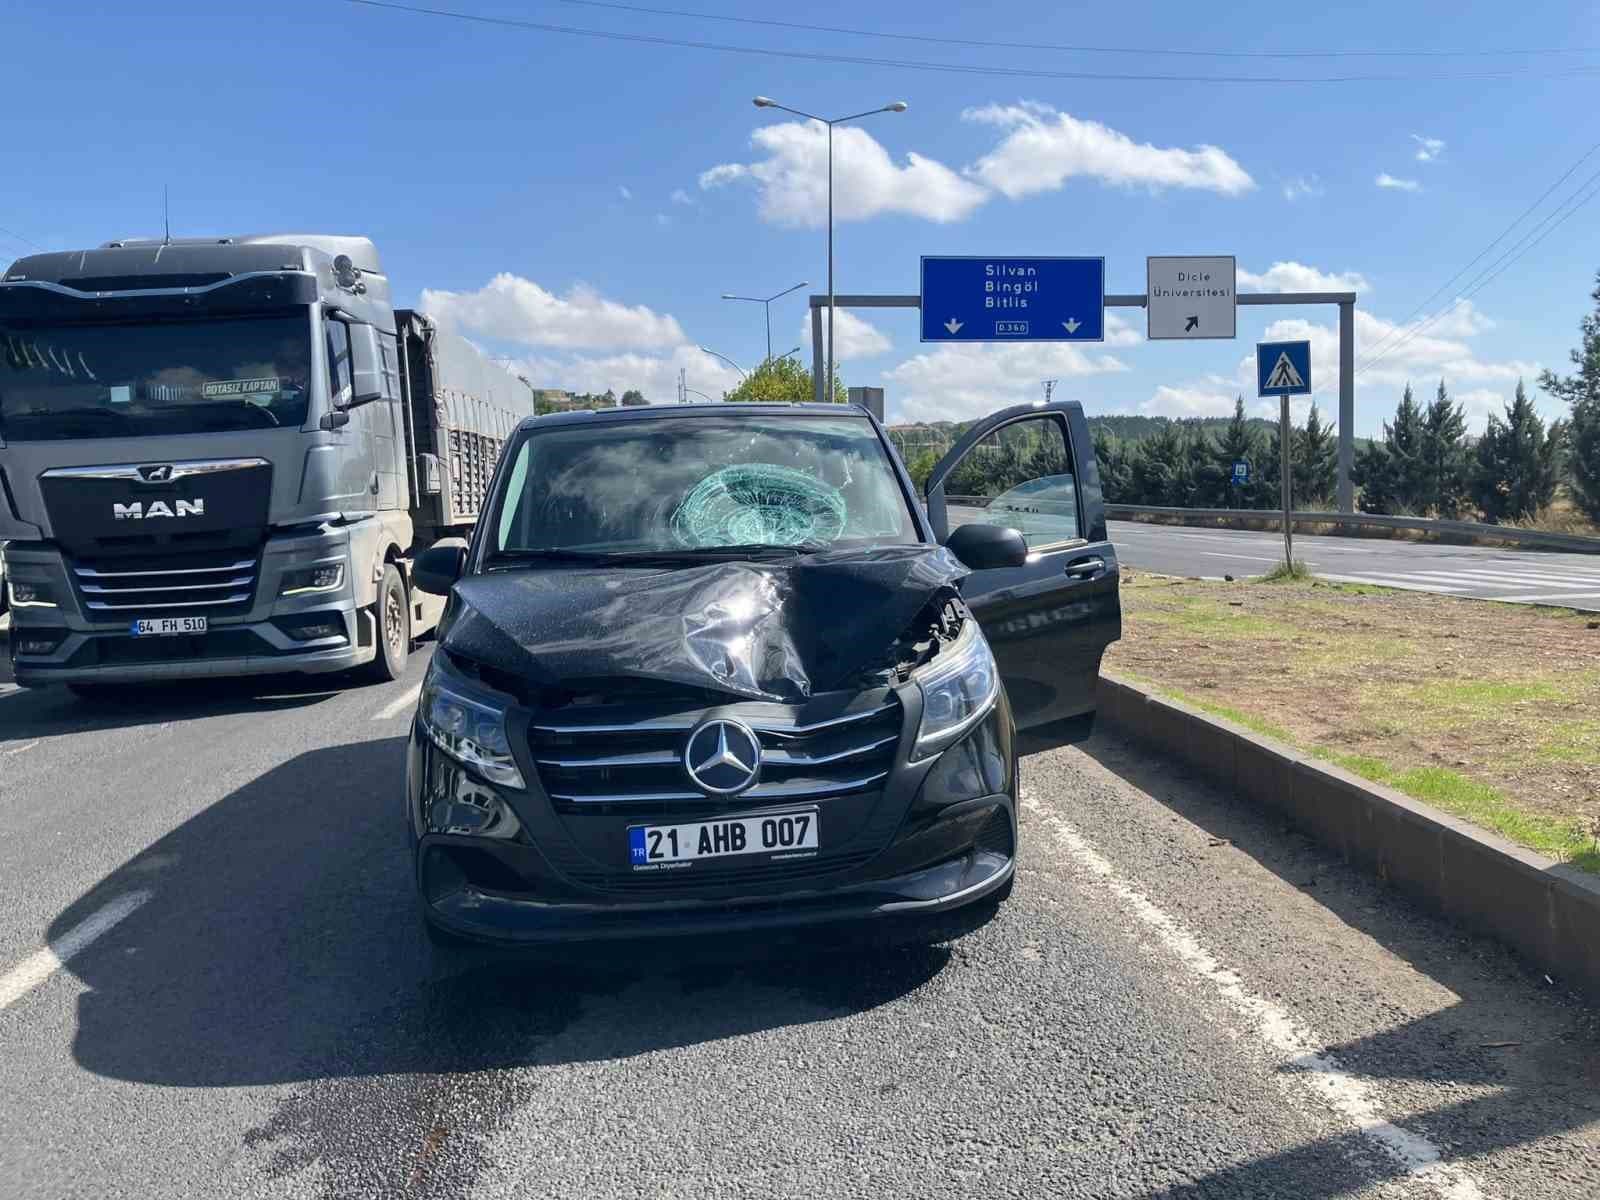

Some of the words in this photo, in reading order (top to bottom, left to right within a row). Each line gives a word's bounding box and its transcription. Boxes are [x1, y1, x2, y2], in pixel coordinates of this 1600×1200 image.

[985, 264, 1036, 276] Silvan
[1178, 271, 1211, 281] Dicle
[985, 280, 1038, 294] Bingöl
[1152, 285, 1231, 297] Üniversitesi
[985, 296, 1028, 308] Bitlis
[242, 380, 277, 393] KAPTAN
[113, 498, 204, 519] MAN
[138, 620, 153, 633] 64
[161, 619, 178, 632] FH
[183, 618, 205, 631] 510
[647, 828, 680, 859] 21
[697, 822, 747, 855] AHB
[761, 816, 810, 848] 007
[632, 848, 646, 857] TR
